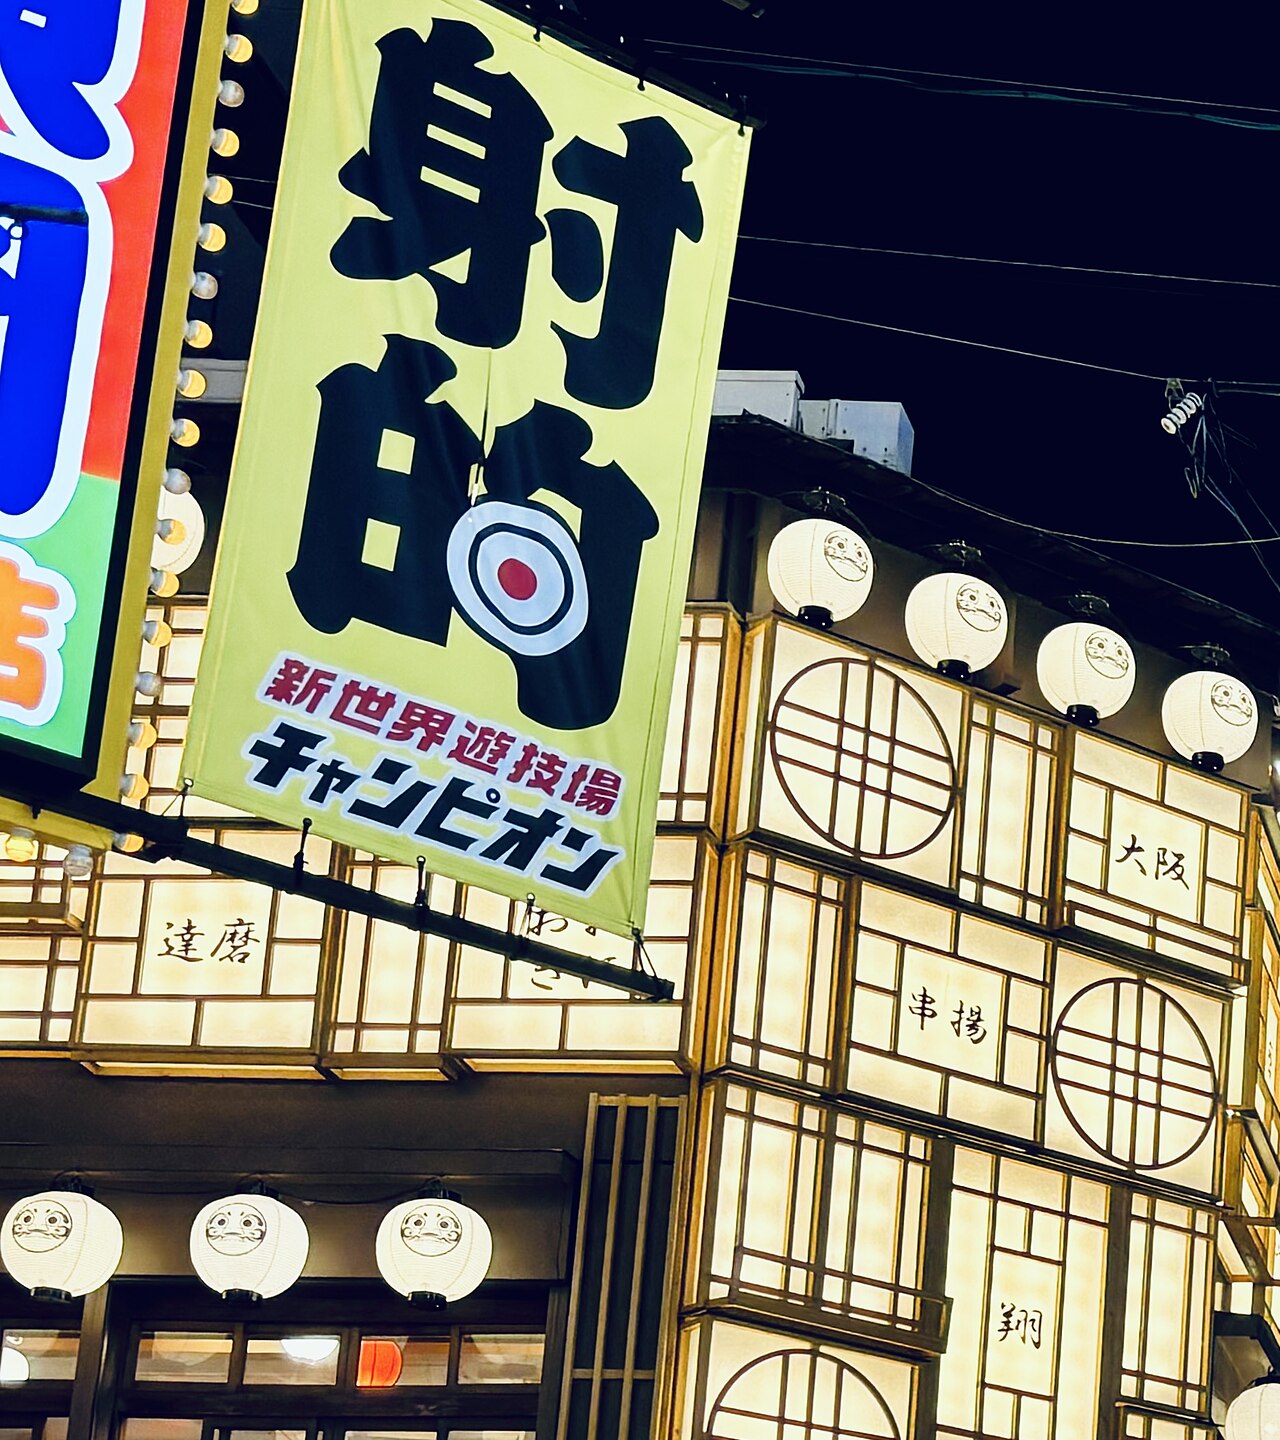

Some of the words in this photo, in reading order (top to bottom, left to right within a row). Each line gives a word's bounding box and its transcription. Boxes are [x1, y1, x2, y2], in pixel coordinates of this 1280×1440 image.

[286, 18, 704, 731] 射的
[262, 656, 624, 818] 新世界遊技場
[247, 722, 624, 894] チャンピオン
[1114, 832, 1190, 891] 大阪
[156, 916, 263, 965] 達磨
[907, 984, 989, 1045] 串揚
[998, 1302, 1043, 1349] 翔
